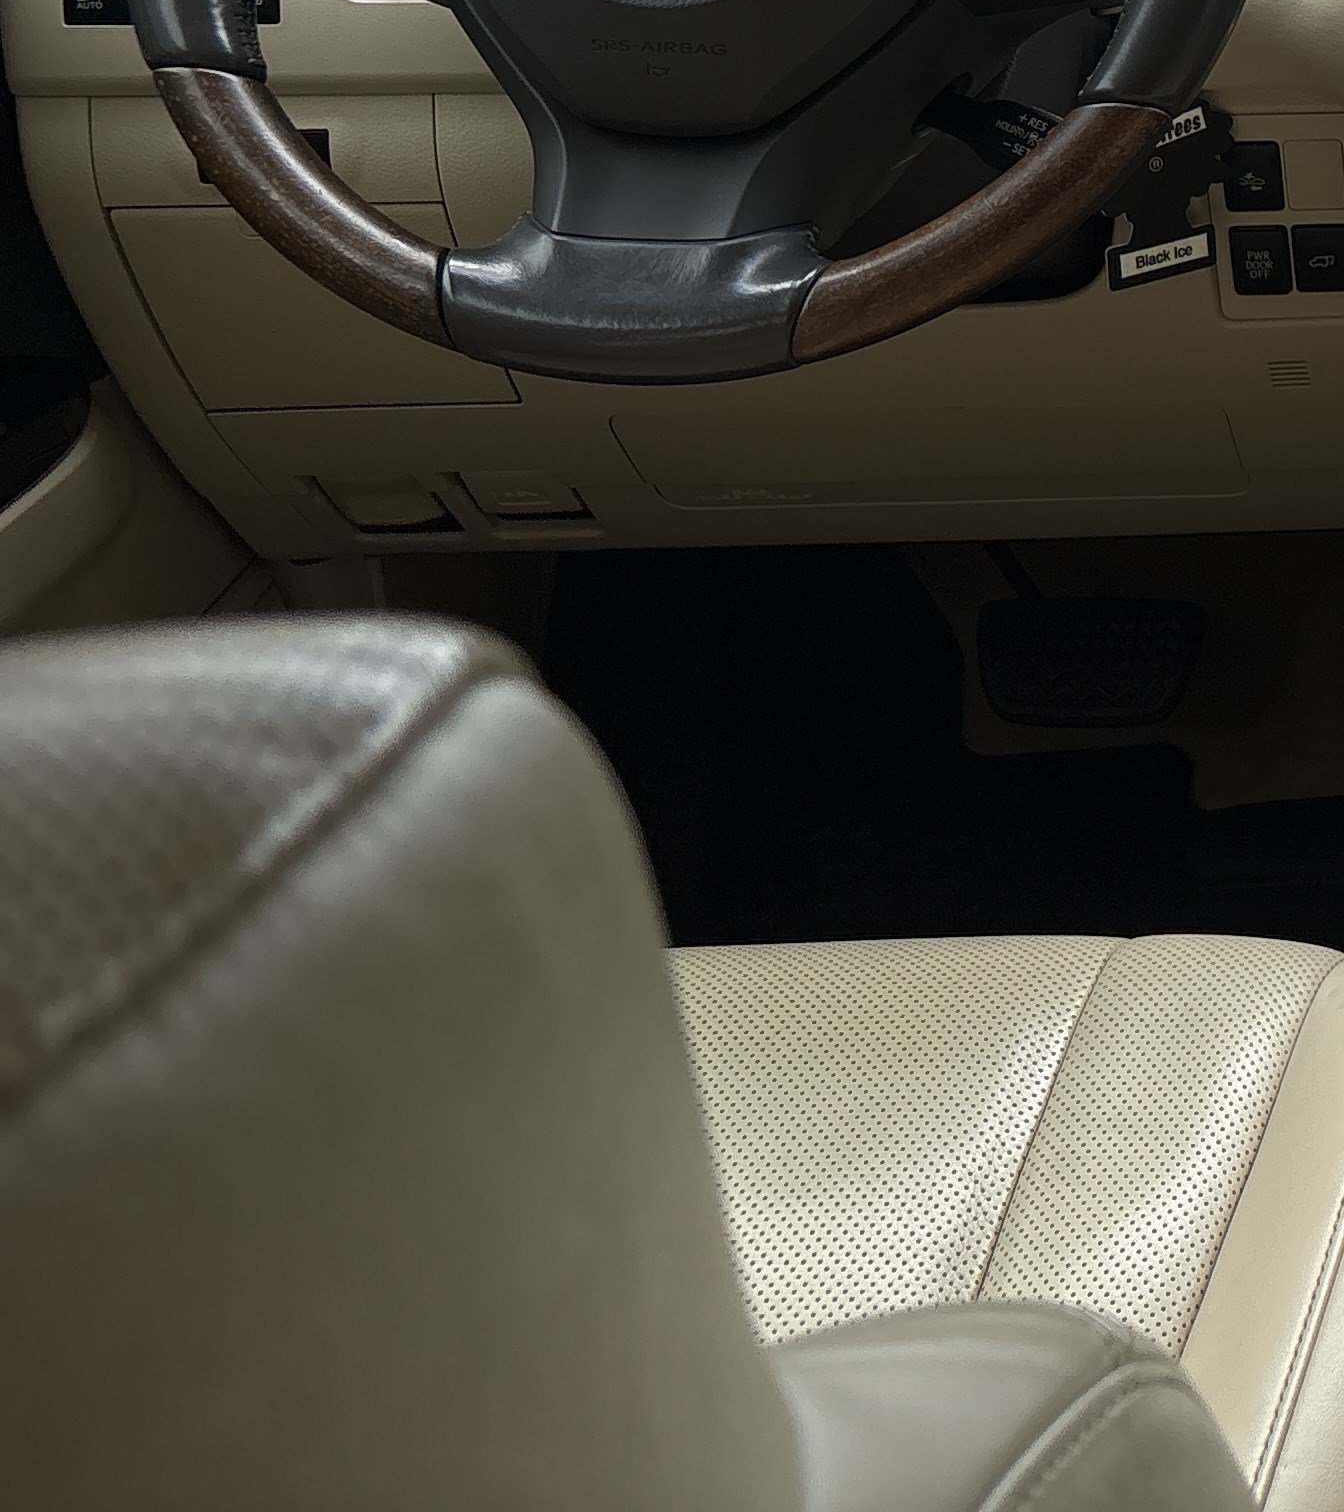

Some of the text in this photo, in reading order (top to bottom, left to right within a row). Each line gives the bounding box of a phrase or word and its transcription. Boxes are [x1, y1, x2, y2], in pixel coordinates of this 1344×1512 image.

[77, 1, 103, 9] AUTO
[1135, 243, 1193, 269] Black Ice
[1247, 251, 1270, 260] PWR
[1246, 260, 1273, 270] DOOR
[1250, 269, 1270, 279] OFF
